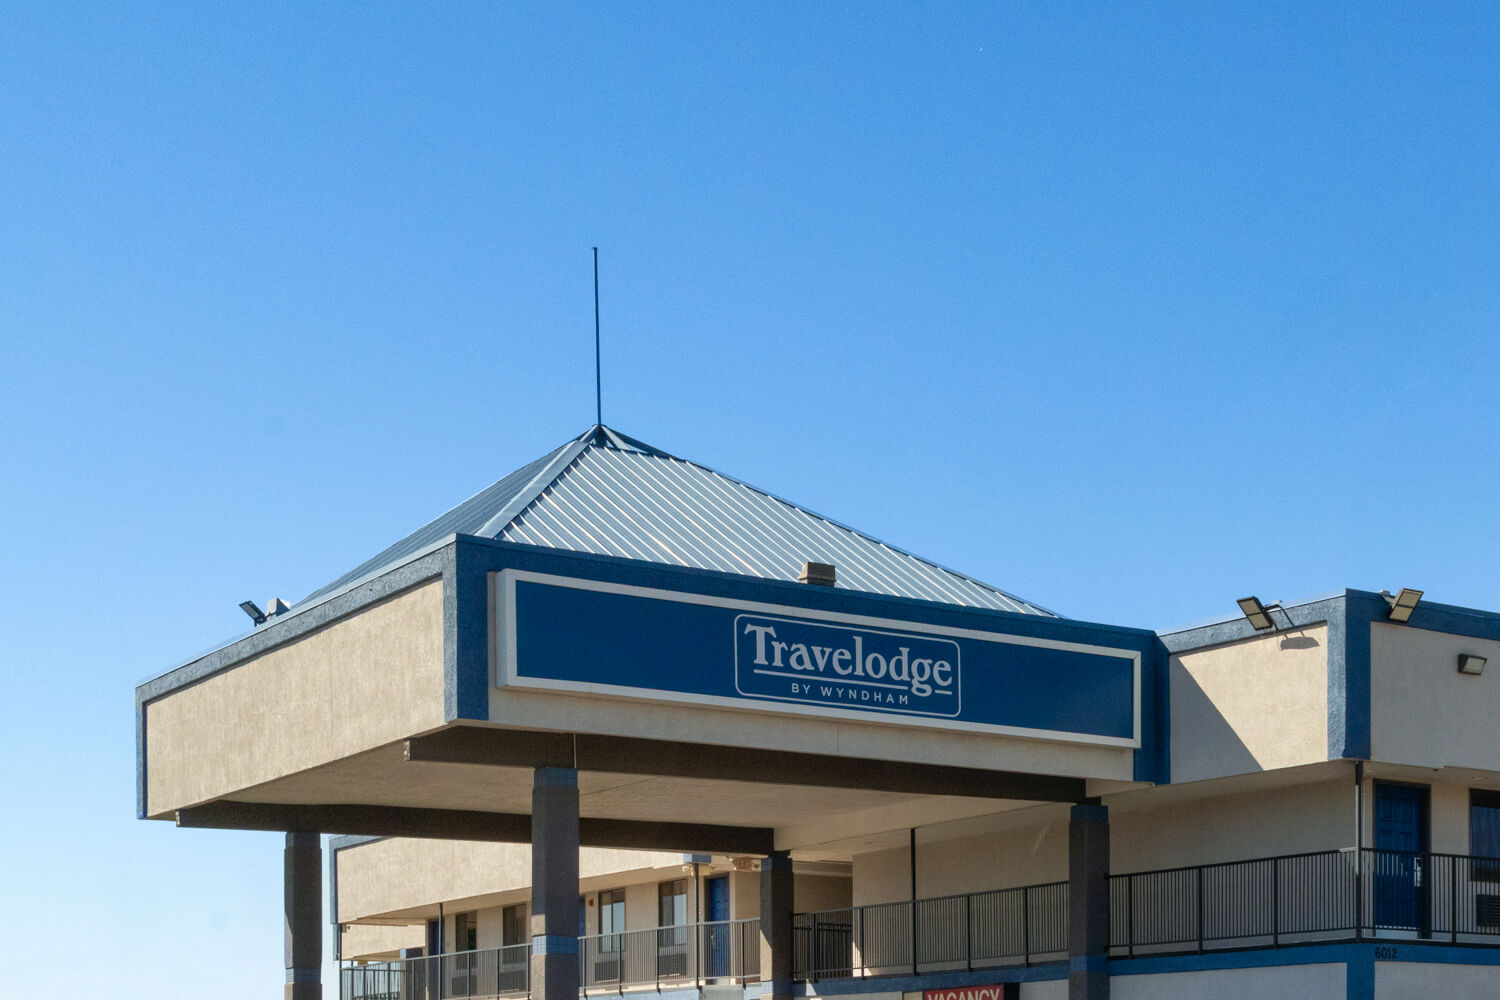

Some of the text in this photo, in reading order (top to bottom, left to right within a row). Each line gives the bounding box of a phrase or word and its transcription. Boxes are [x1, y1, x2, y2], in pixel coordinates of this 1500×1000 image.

[744, 623, 953, 697] Travelodge
[791, 682, 909, 705] BY WYNDHAM
[1375, 946, 1398, 960] 6012
